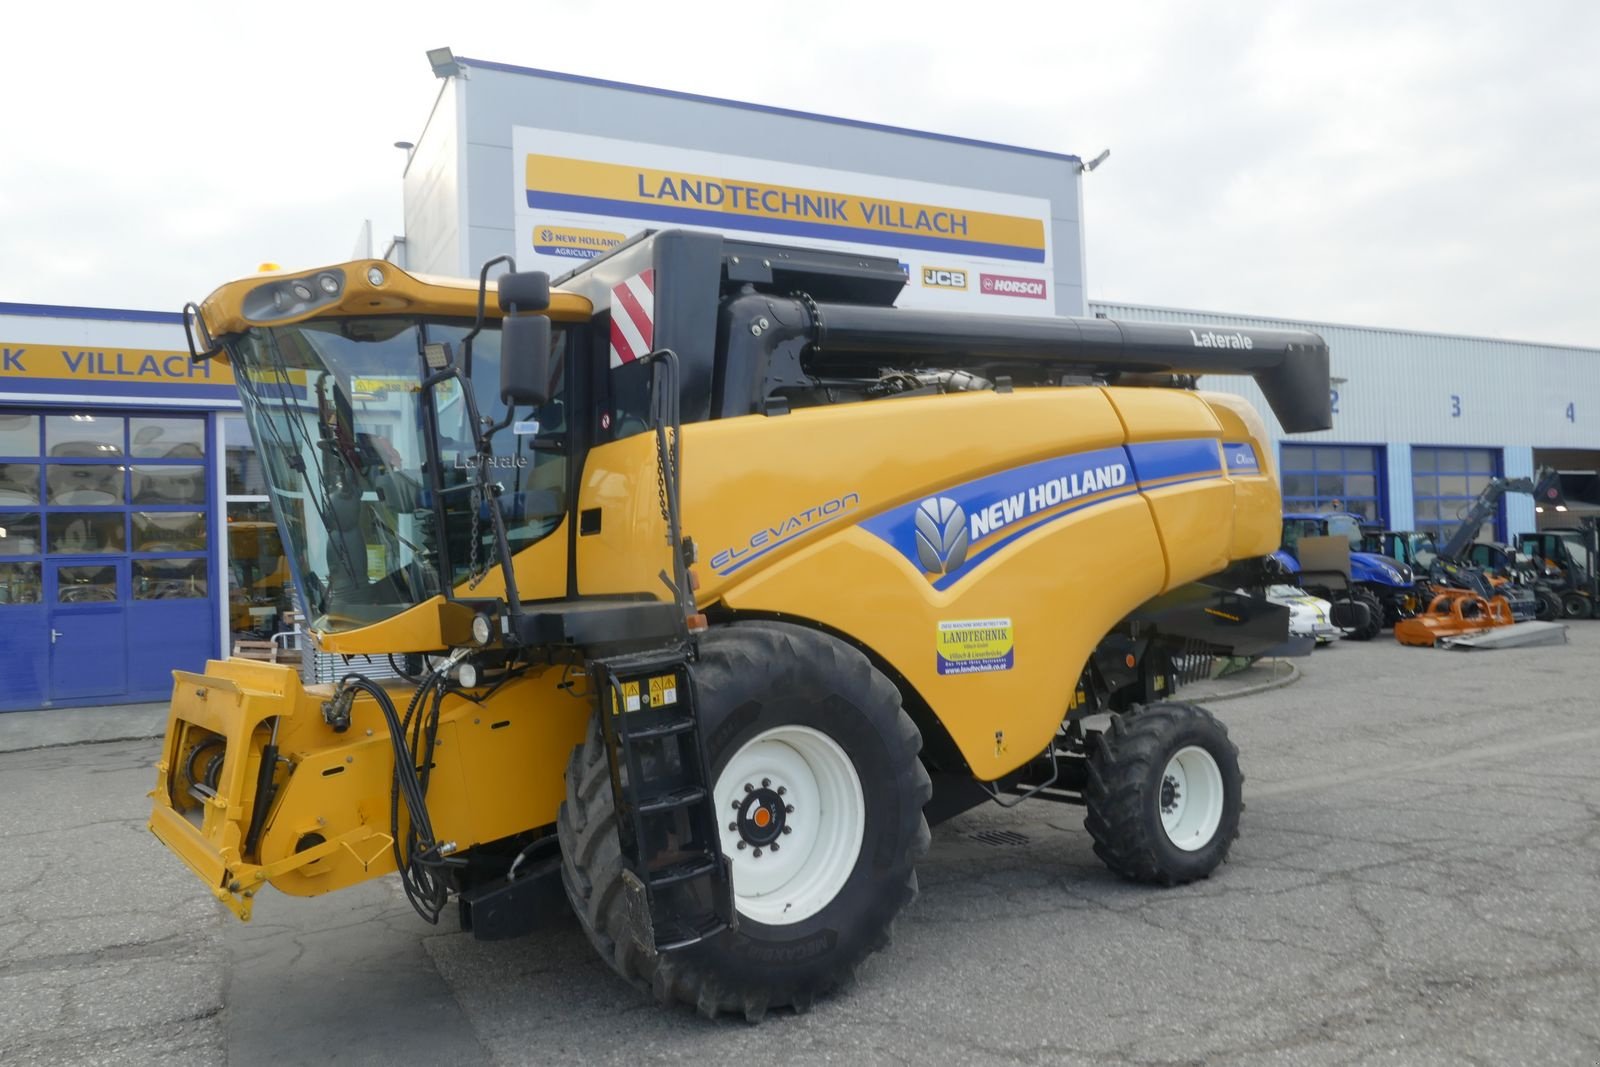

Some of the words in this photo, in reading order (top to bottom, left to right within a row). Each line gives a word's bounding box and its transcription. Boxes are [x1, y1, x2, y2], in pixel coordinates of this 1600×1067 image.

[638, 173, 848, 222] LANDTECHNIK
[859, 201, 968, 236] VILLACH
[555, 234, 577, 243] NEW
[924, 269, 965, 288] JCB
[994, 279, 1043, 295] HORSCH
[1189, 328, 1254, 350] Laterale
[3, 348, 27, 372] K
[62, 351, 211, 379] VILLACH
[1451, 395, 1462, 418] 3
[1565, 401, 1576, 424] 4
[970, 491, 1026, 541] NEW
[1028, 463, 1127, 513] HOLLAND
[709, 492, 860, 570] ELEVATION
[943, 629, 1008, 644] LANDTECHNIK
